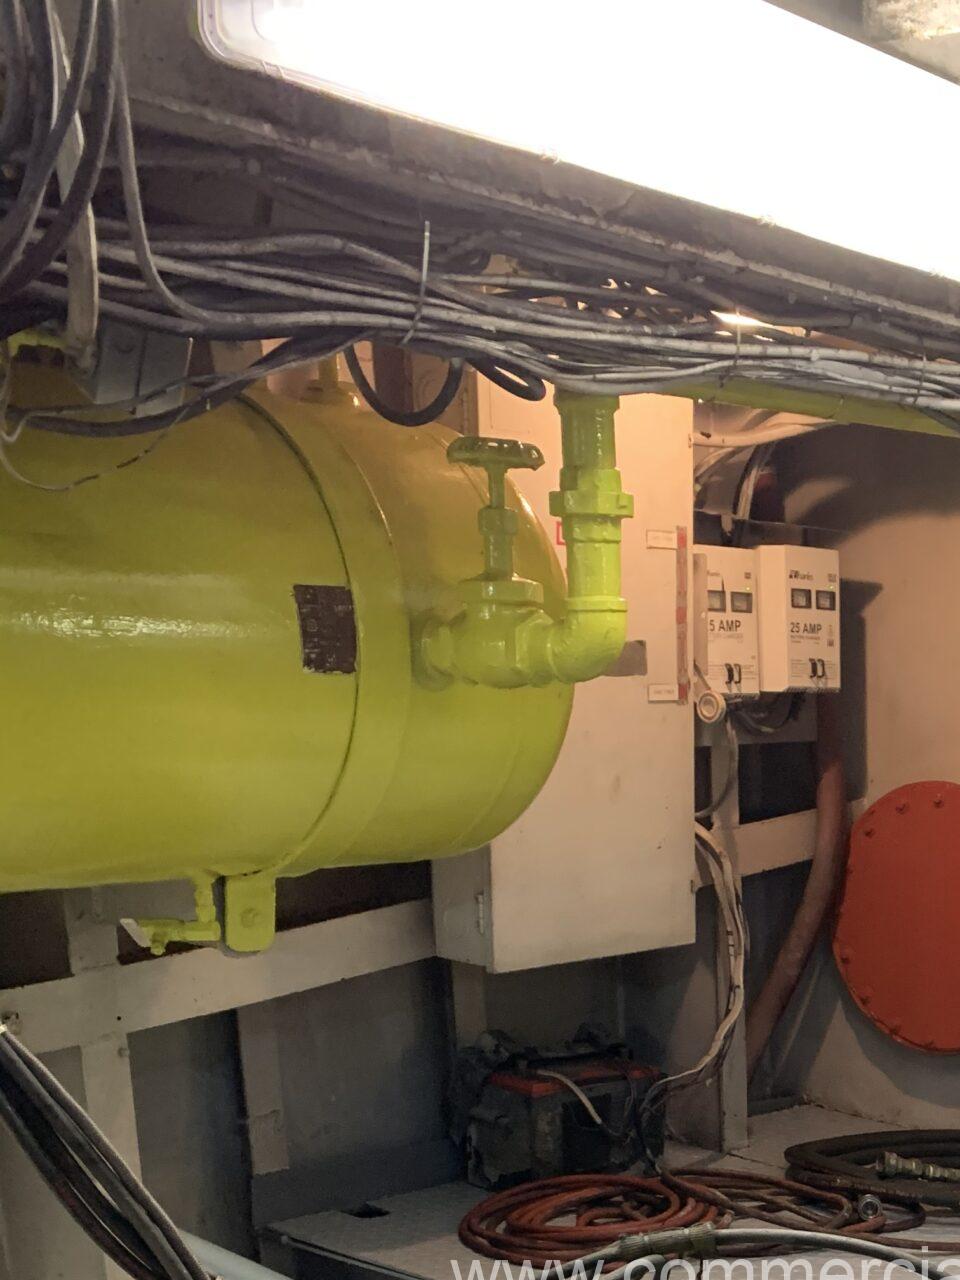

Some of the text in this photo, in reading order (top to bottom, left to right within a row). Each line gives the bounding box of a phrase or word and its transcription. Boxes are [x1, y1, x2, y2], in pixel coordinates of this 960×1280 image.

[718, 619, 742, 632] AMP
[789, 622, 823, 635] 25 AMP
